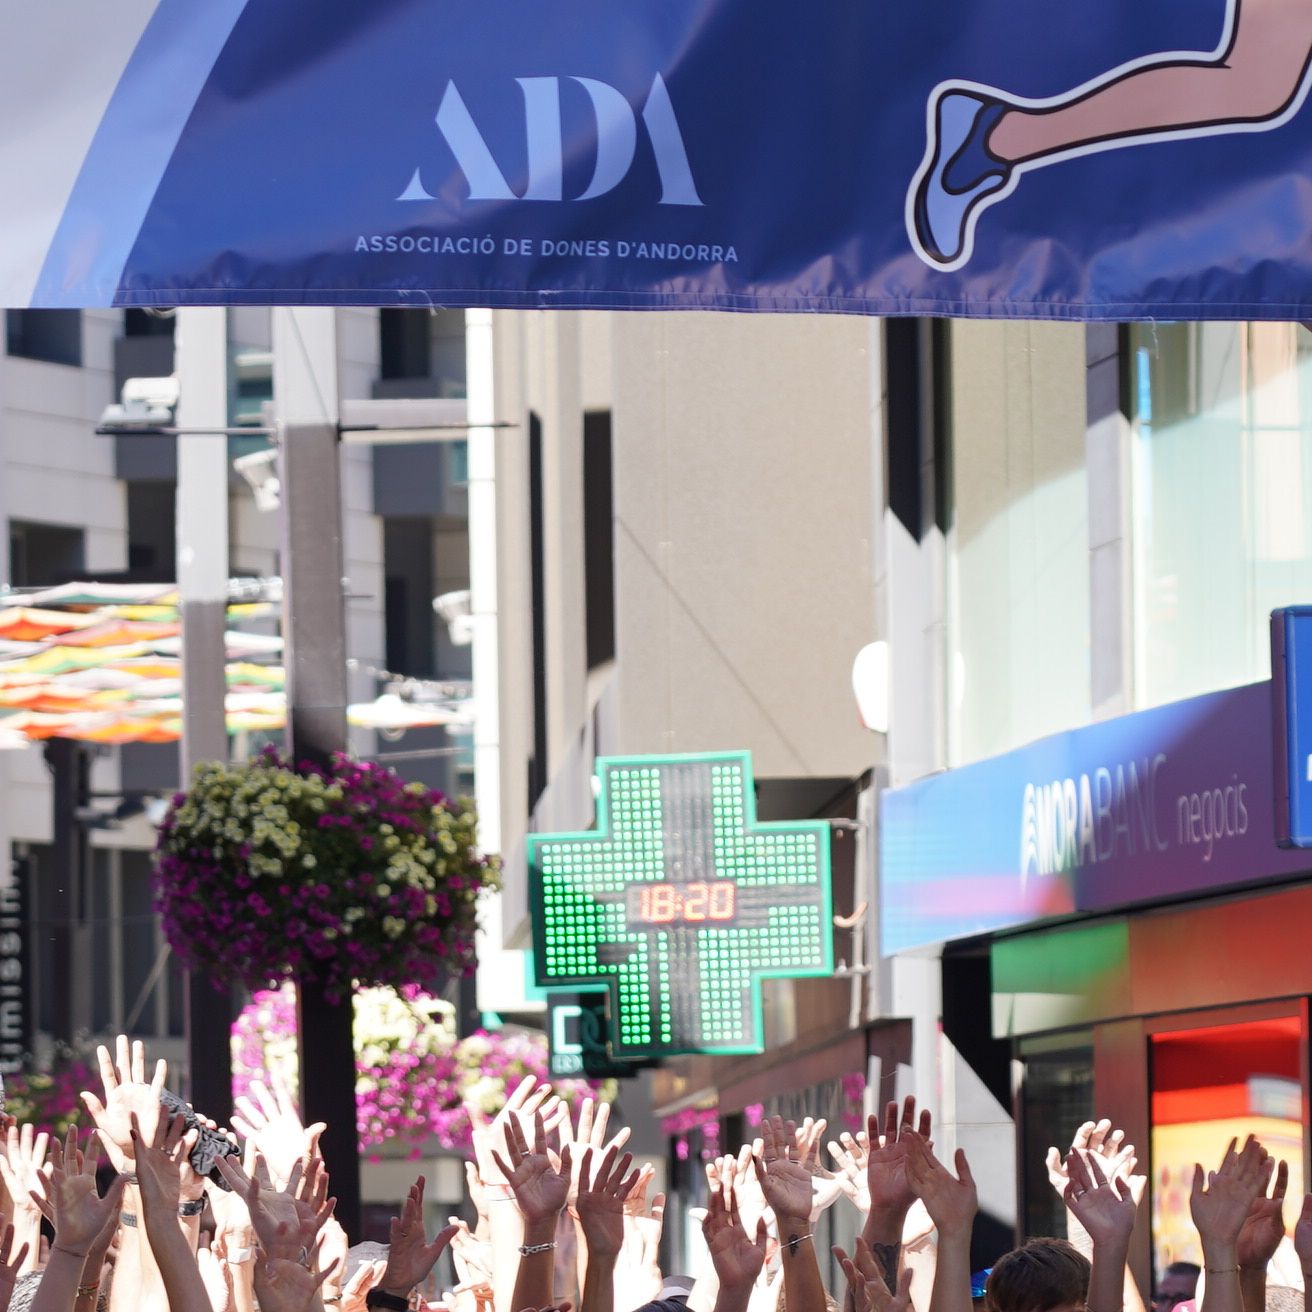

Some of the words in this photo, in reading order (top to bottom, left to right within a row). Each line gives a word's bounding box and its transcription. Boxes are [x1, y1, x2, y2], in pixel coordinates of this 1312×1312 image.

[394, 71, 706, 206] ADA
[354, 233, 496, 256] ASSOCIACIÓ
[503, 238, 533, 257] DE
[540, 239, 610, 258] DONES
[616, 241, 738, 263] D'ANDORRA
[1034, 752, 1169, 877] MORABANC
[1177, 773, 1249, 862] negocis
[640, 882, 736, 922] 18:20
